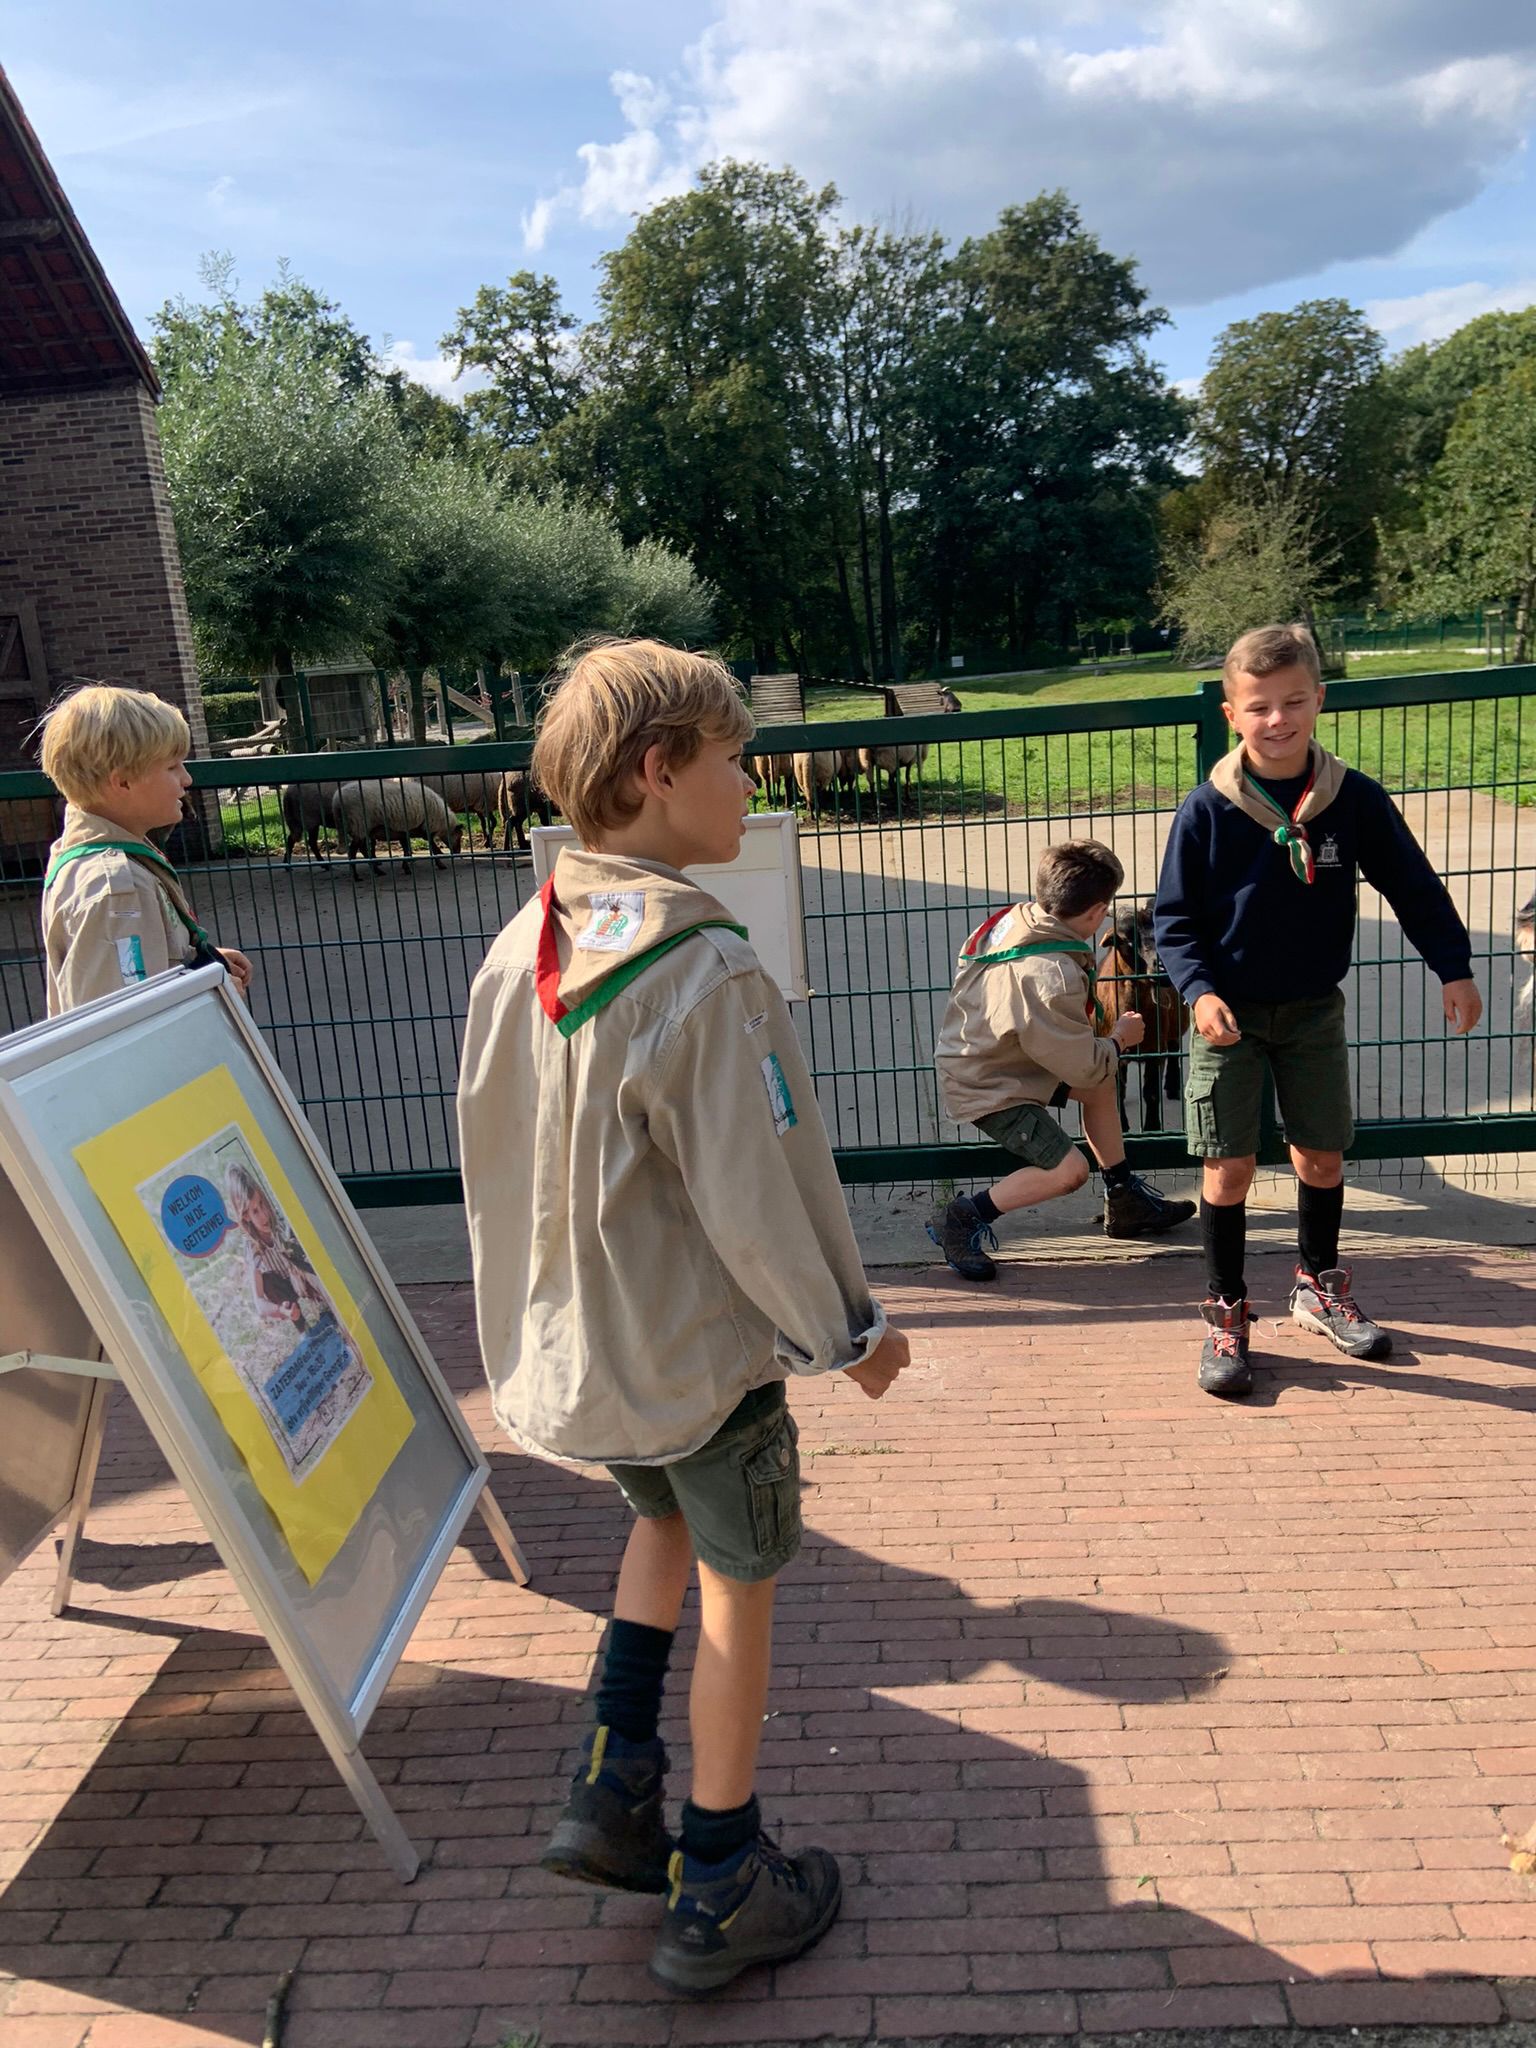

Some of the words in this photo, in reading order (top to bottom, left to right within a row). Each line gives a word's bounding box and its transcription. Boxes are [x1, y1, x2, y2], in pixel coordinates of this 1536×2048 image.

[168, 1184, 204, 1216] WELKOM
[184, 1214, 195, 1227] IN
[193, 1204, 206, 1220] DE
[183, 1211, 224, 1251] GEITENWEI
[270, 1358, 305, 1399] ZATERDAG
